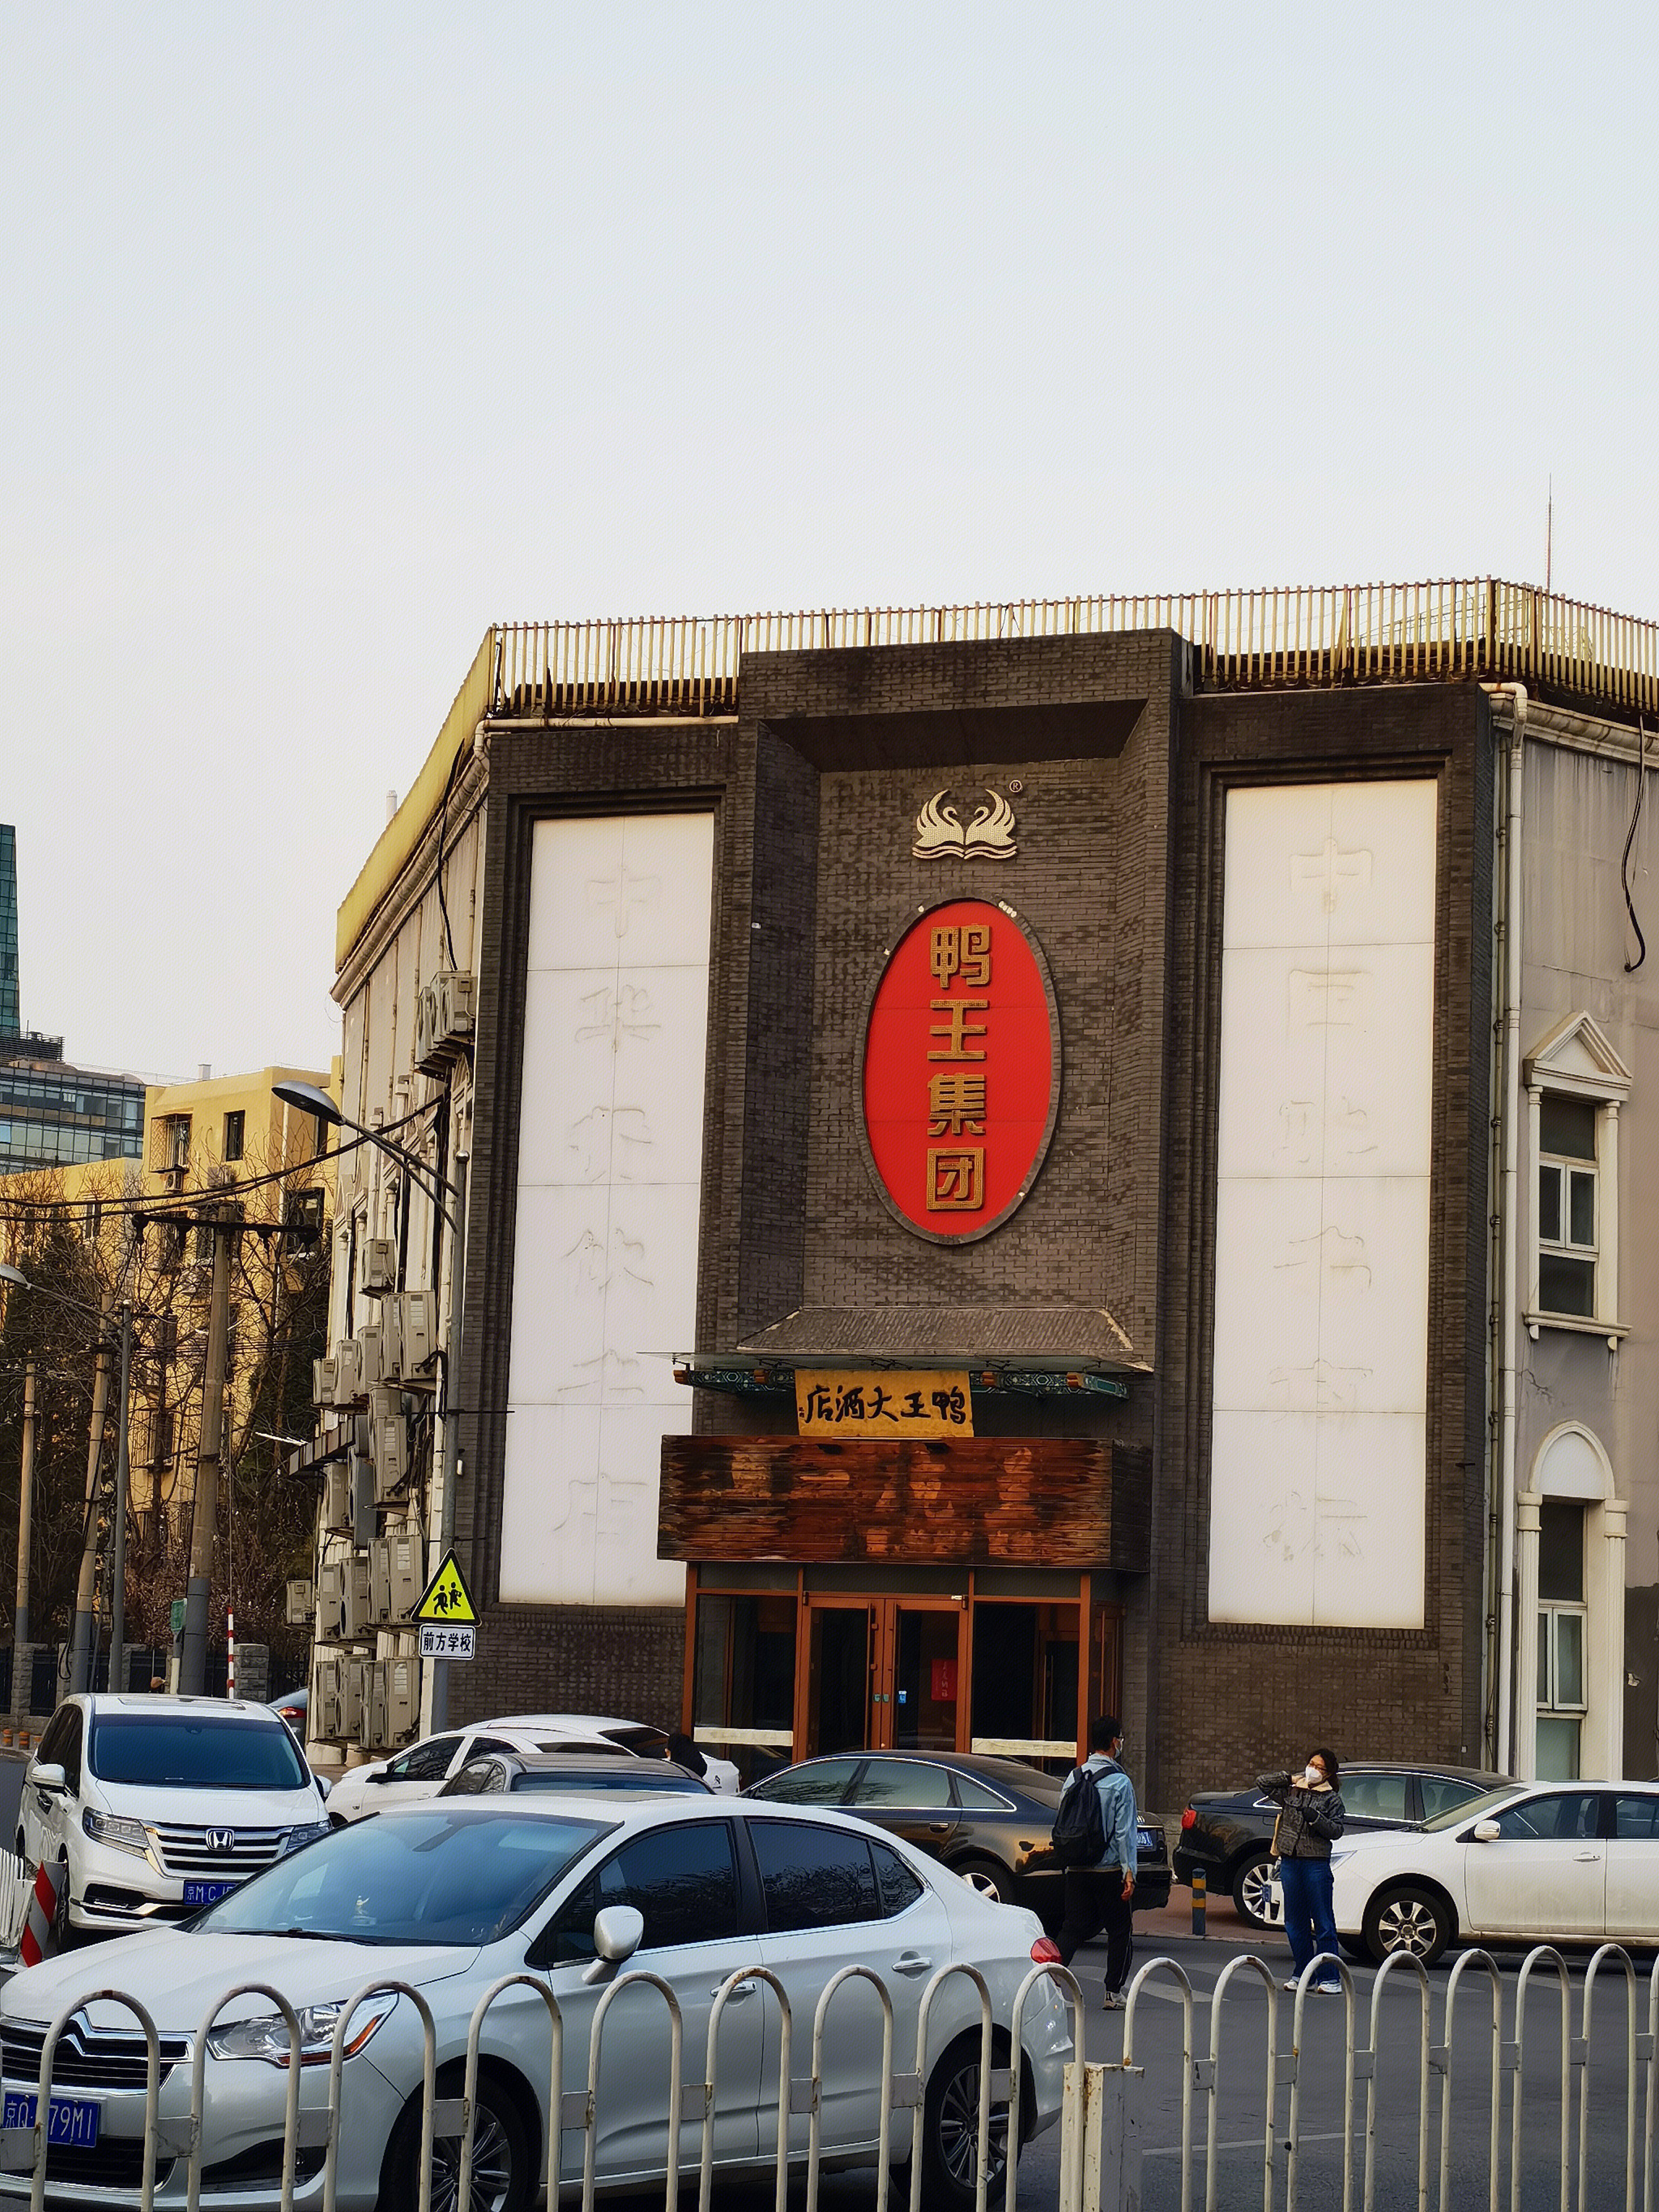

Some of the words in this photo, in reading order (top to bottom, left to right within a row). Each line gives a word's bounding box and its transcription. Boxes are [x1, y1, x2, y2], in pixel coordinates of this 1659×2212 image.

[926, 925, 993, 1212] 鸭王集团
[423, 1631, 471, 1652] 前方学校
[6, 2100, 92, 2140] 京Q·79M1
